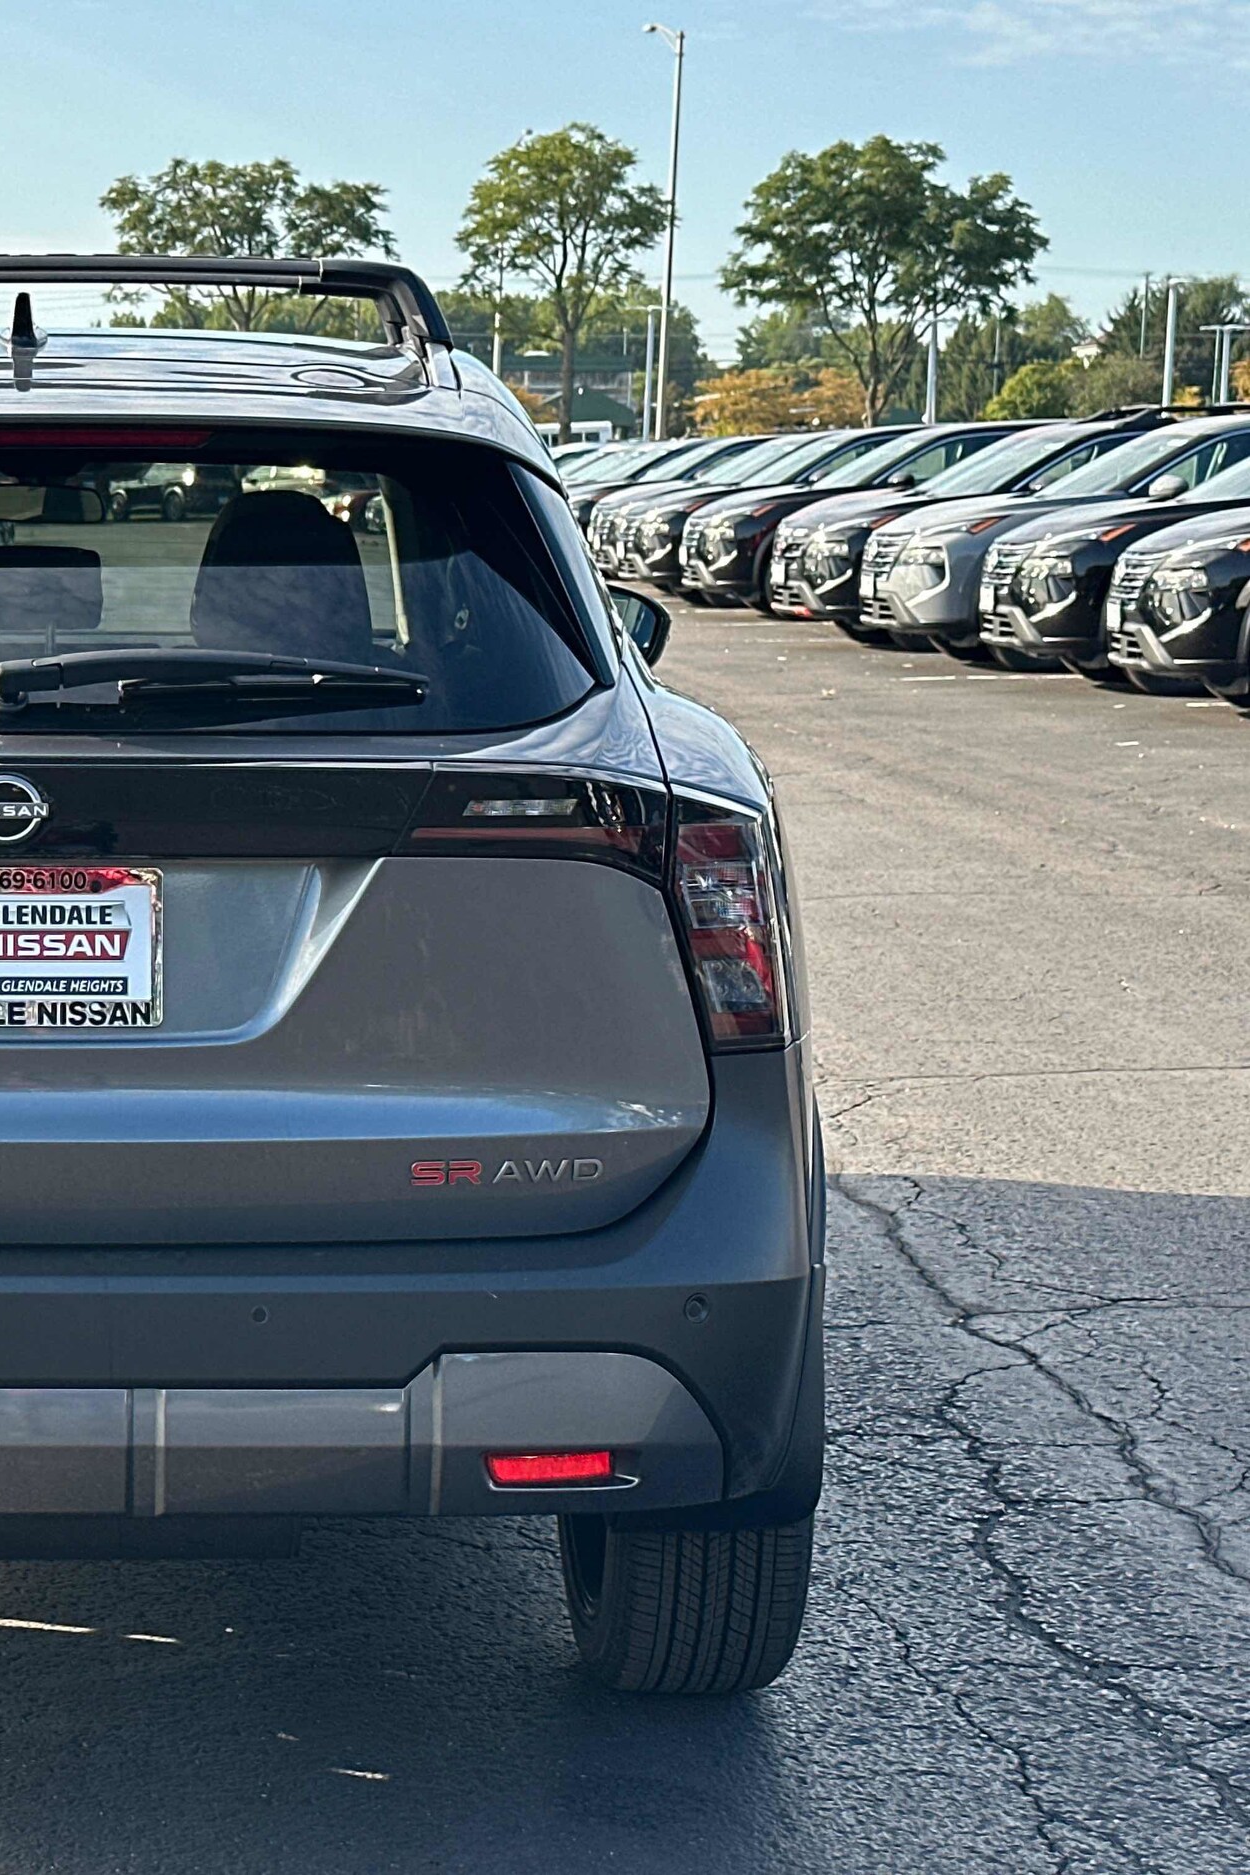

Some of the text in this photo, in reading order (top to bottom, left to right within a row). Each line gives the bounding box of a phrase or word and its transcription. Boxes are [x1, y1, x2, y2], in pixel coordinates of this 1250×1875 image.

[1, 979, 67, 992] GLENDALE
[70, 979, 124, 992] HEIGHTS
[37, 1001, 151, 1025] NISSAN
[410, 1158, 604, 1186] SR AWD
